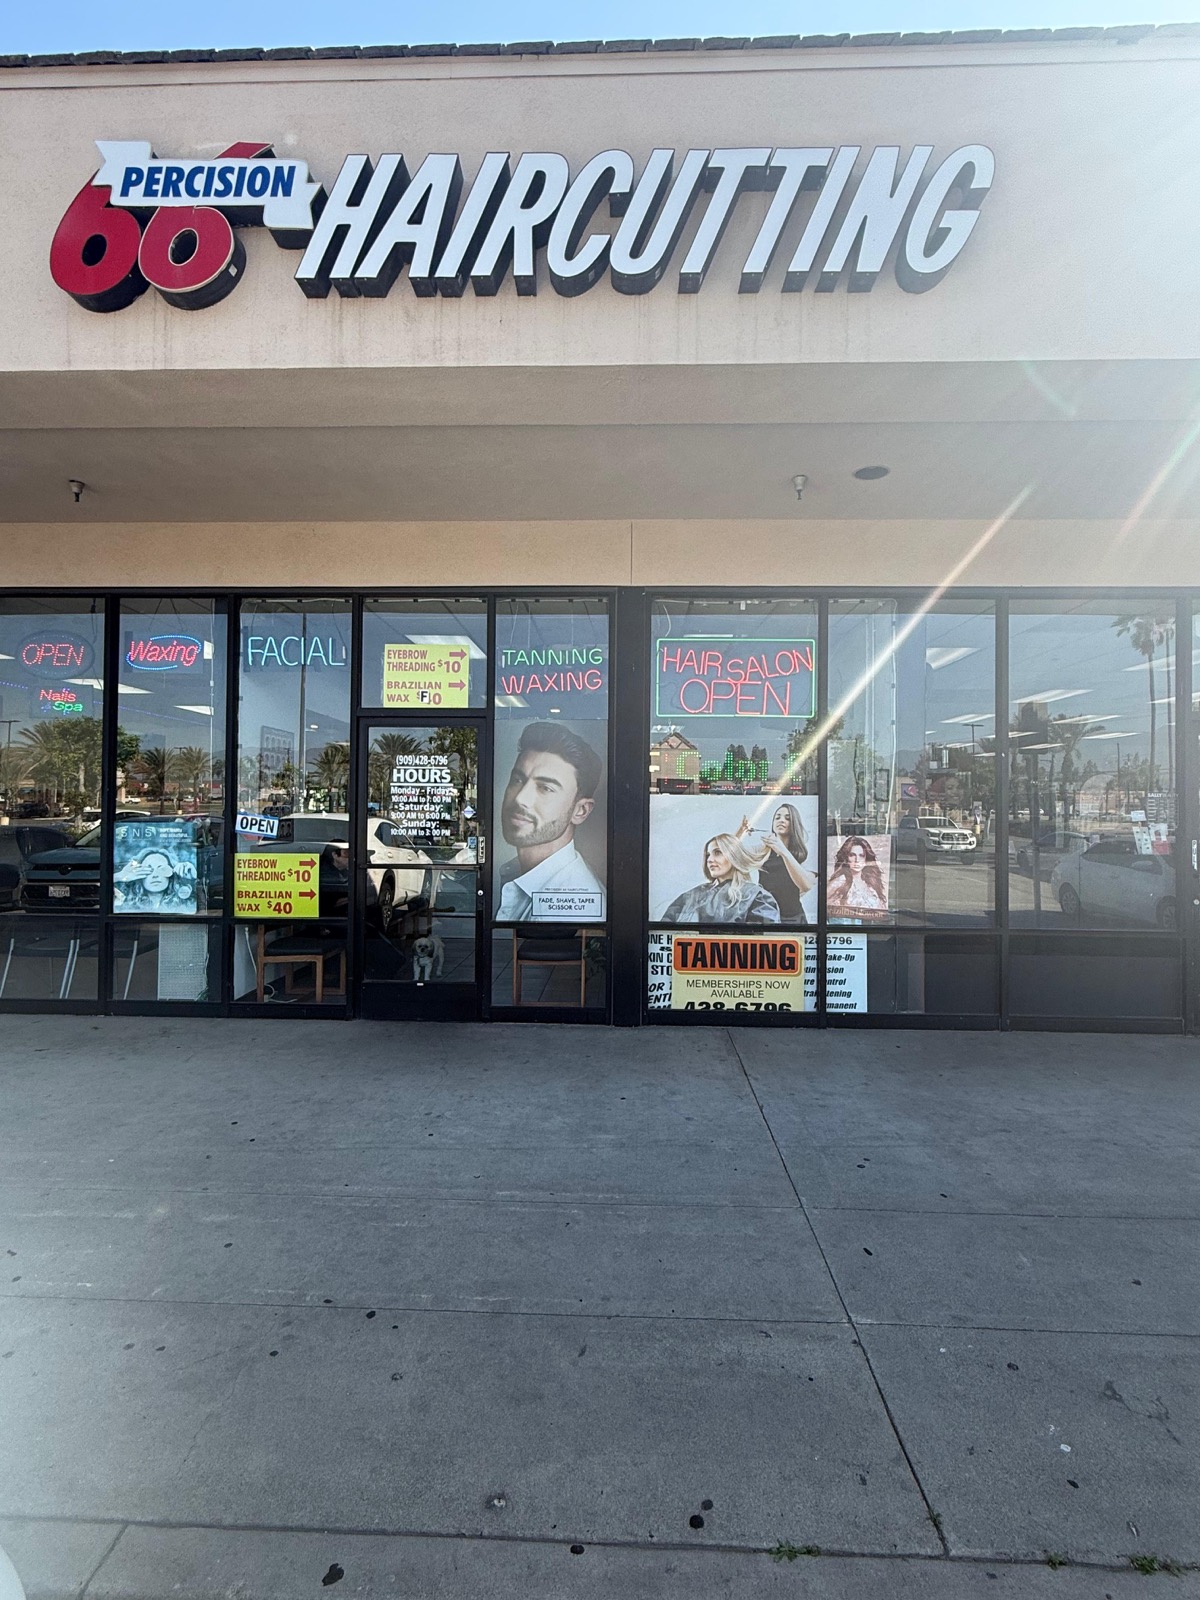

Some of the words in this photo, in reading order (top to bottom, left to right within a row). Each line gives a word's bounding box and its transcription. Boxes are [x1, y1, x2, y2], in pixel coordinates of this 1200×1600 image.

[119, 165, 297, 198] PERCISION
[50, 141, 274, 295] 66
[294, 144, 996, 280] HAIRCUTTING
[22, 643, 84, 666] OPEN
[129, 640, 199, 667] Waxing
[247, 636, 346, 666] FACIAL
[387, 649, 428, 660] EYEBROW
[502, 648, 603, 666] TANNING
[386, 661, 436, 672] THREADING
[437, 658, 462, 674] $10
[663, 646, 723, 678] HAIR
[726, 646, 814, 683] SALON
[386, 680, 442, 690] BRAZILIAN
[501, 669, 602, 694] WAXING
[39, 688, 77, 702] Nails
[386, 693, 410, 703] WAX
[420, 690, 429, 703] F
[679, 678, 791, 716] OPEN
[52, 700, 84, 713] Spa
[396, 754, 448, 766] (909)428-6796
[676, 751, 773, 781] Color
[392, 768, 451, 783] HOURS
[390, 786, 421, 796] Monday
[391, 795, 407, 803] 10:00
[408, 795, 418, 803] AM
[419, 795, 426, 803] to
[442, 795, 452, 803] PM
[398, 803, 444, 813] Saturday:
[390, 811, 406, 820] 9:00
[406, 811, 417, 820] AM
[417, 811, 424, 820] to
[425, 811, 440, 820] 6:00
[240, 816, 275, 834] OPEN
[402, 819, 440, 829] Sunday:
[390, 828, 407, 836] 10:00
[407, 828, 418, 836] AM
[418, 828, 425, 836] to
[441, 828, 451, 836] PM
[237, 858, 278, 869] EYEBROW
[237, 870, 286, 882] THREADING
[287, 867, 311, 883] $10
[237, 890, 292, 899] BRAZILIAN
[556, 897, 577, 905] SHAVE,
[237, 903, 261, 912] WAX
[266, 900, 293, 915] $40
[676, 941, 796, 971] TANNING
[826, 953, 856, 962] ake-Up
[686, 979, 762, 990] MEMBERSHIPS
[765, 980, 791, 990] NOW
[710, 989, 765, 999] AVAILABLE
